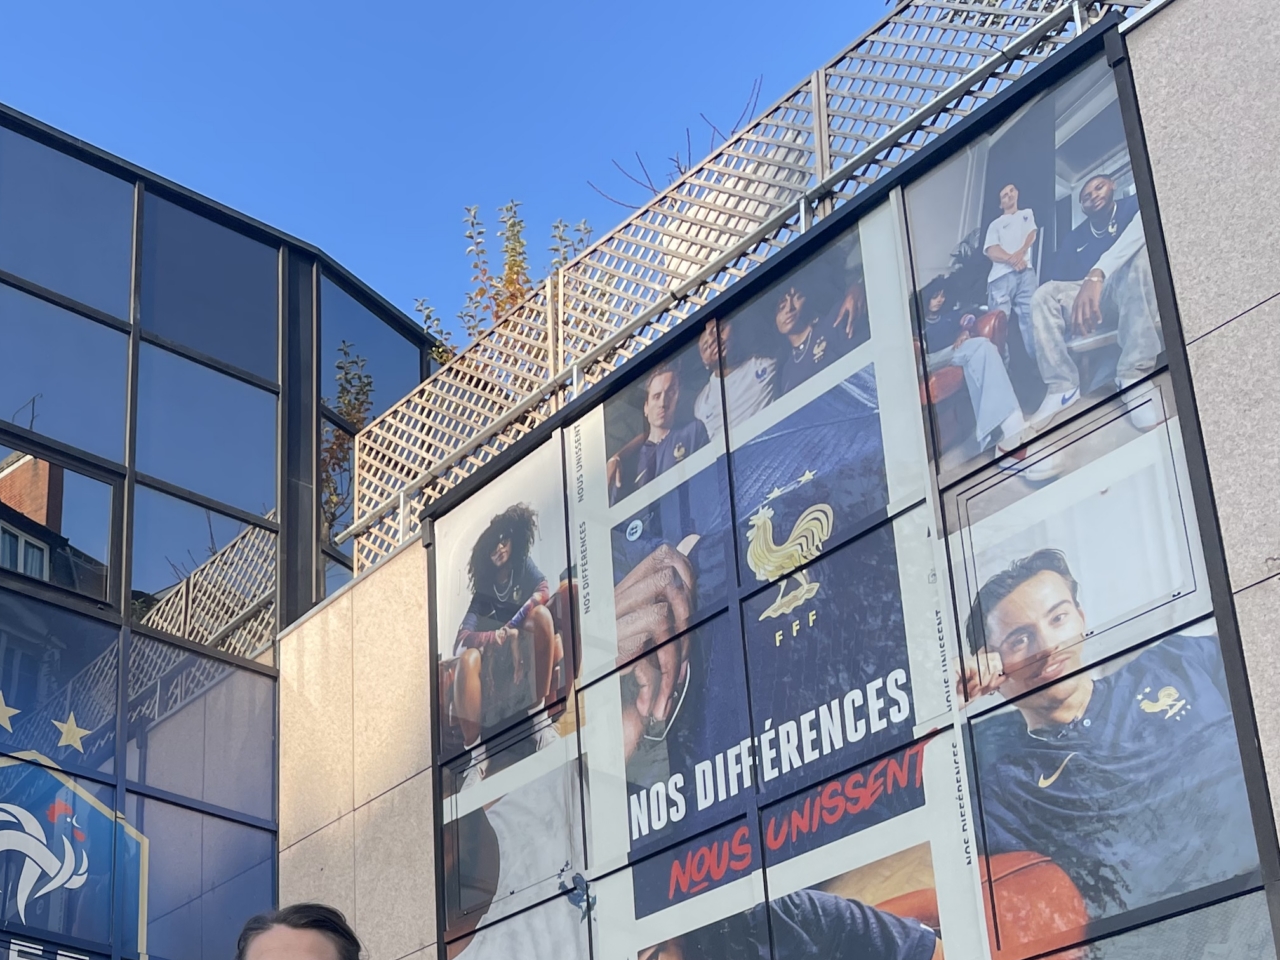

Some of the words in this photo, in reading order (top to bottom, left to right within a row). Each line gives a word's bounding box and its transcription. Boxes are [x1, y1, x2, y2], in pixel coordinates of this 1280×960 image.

[573, 424, 583, 471] UNISSENT
[576, 473, 584, 503] NOUS
[579, 521, 590, 591] DIFFÉRENCES
[583, 592, 591, 615] NOS
[630, 773, 687, 841] NOS
[695, 668, 911, 811] DIFFÉRENCES
[668, 826, 752, 900] NOUS
[766, 727, 939, 850] UNISSENT
